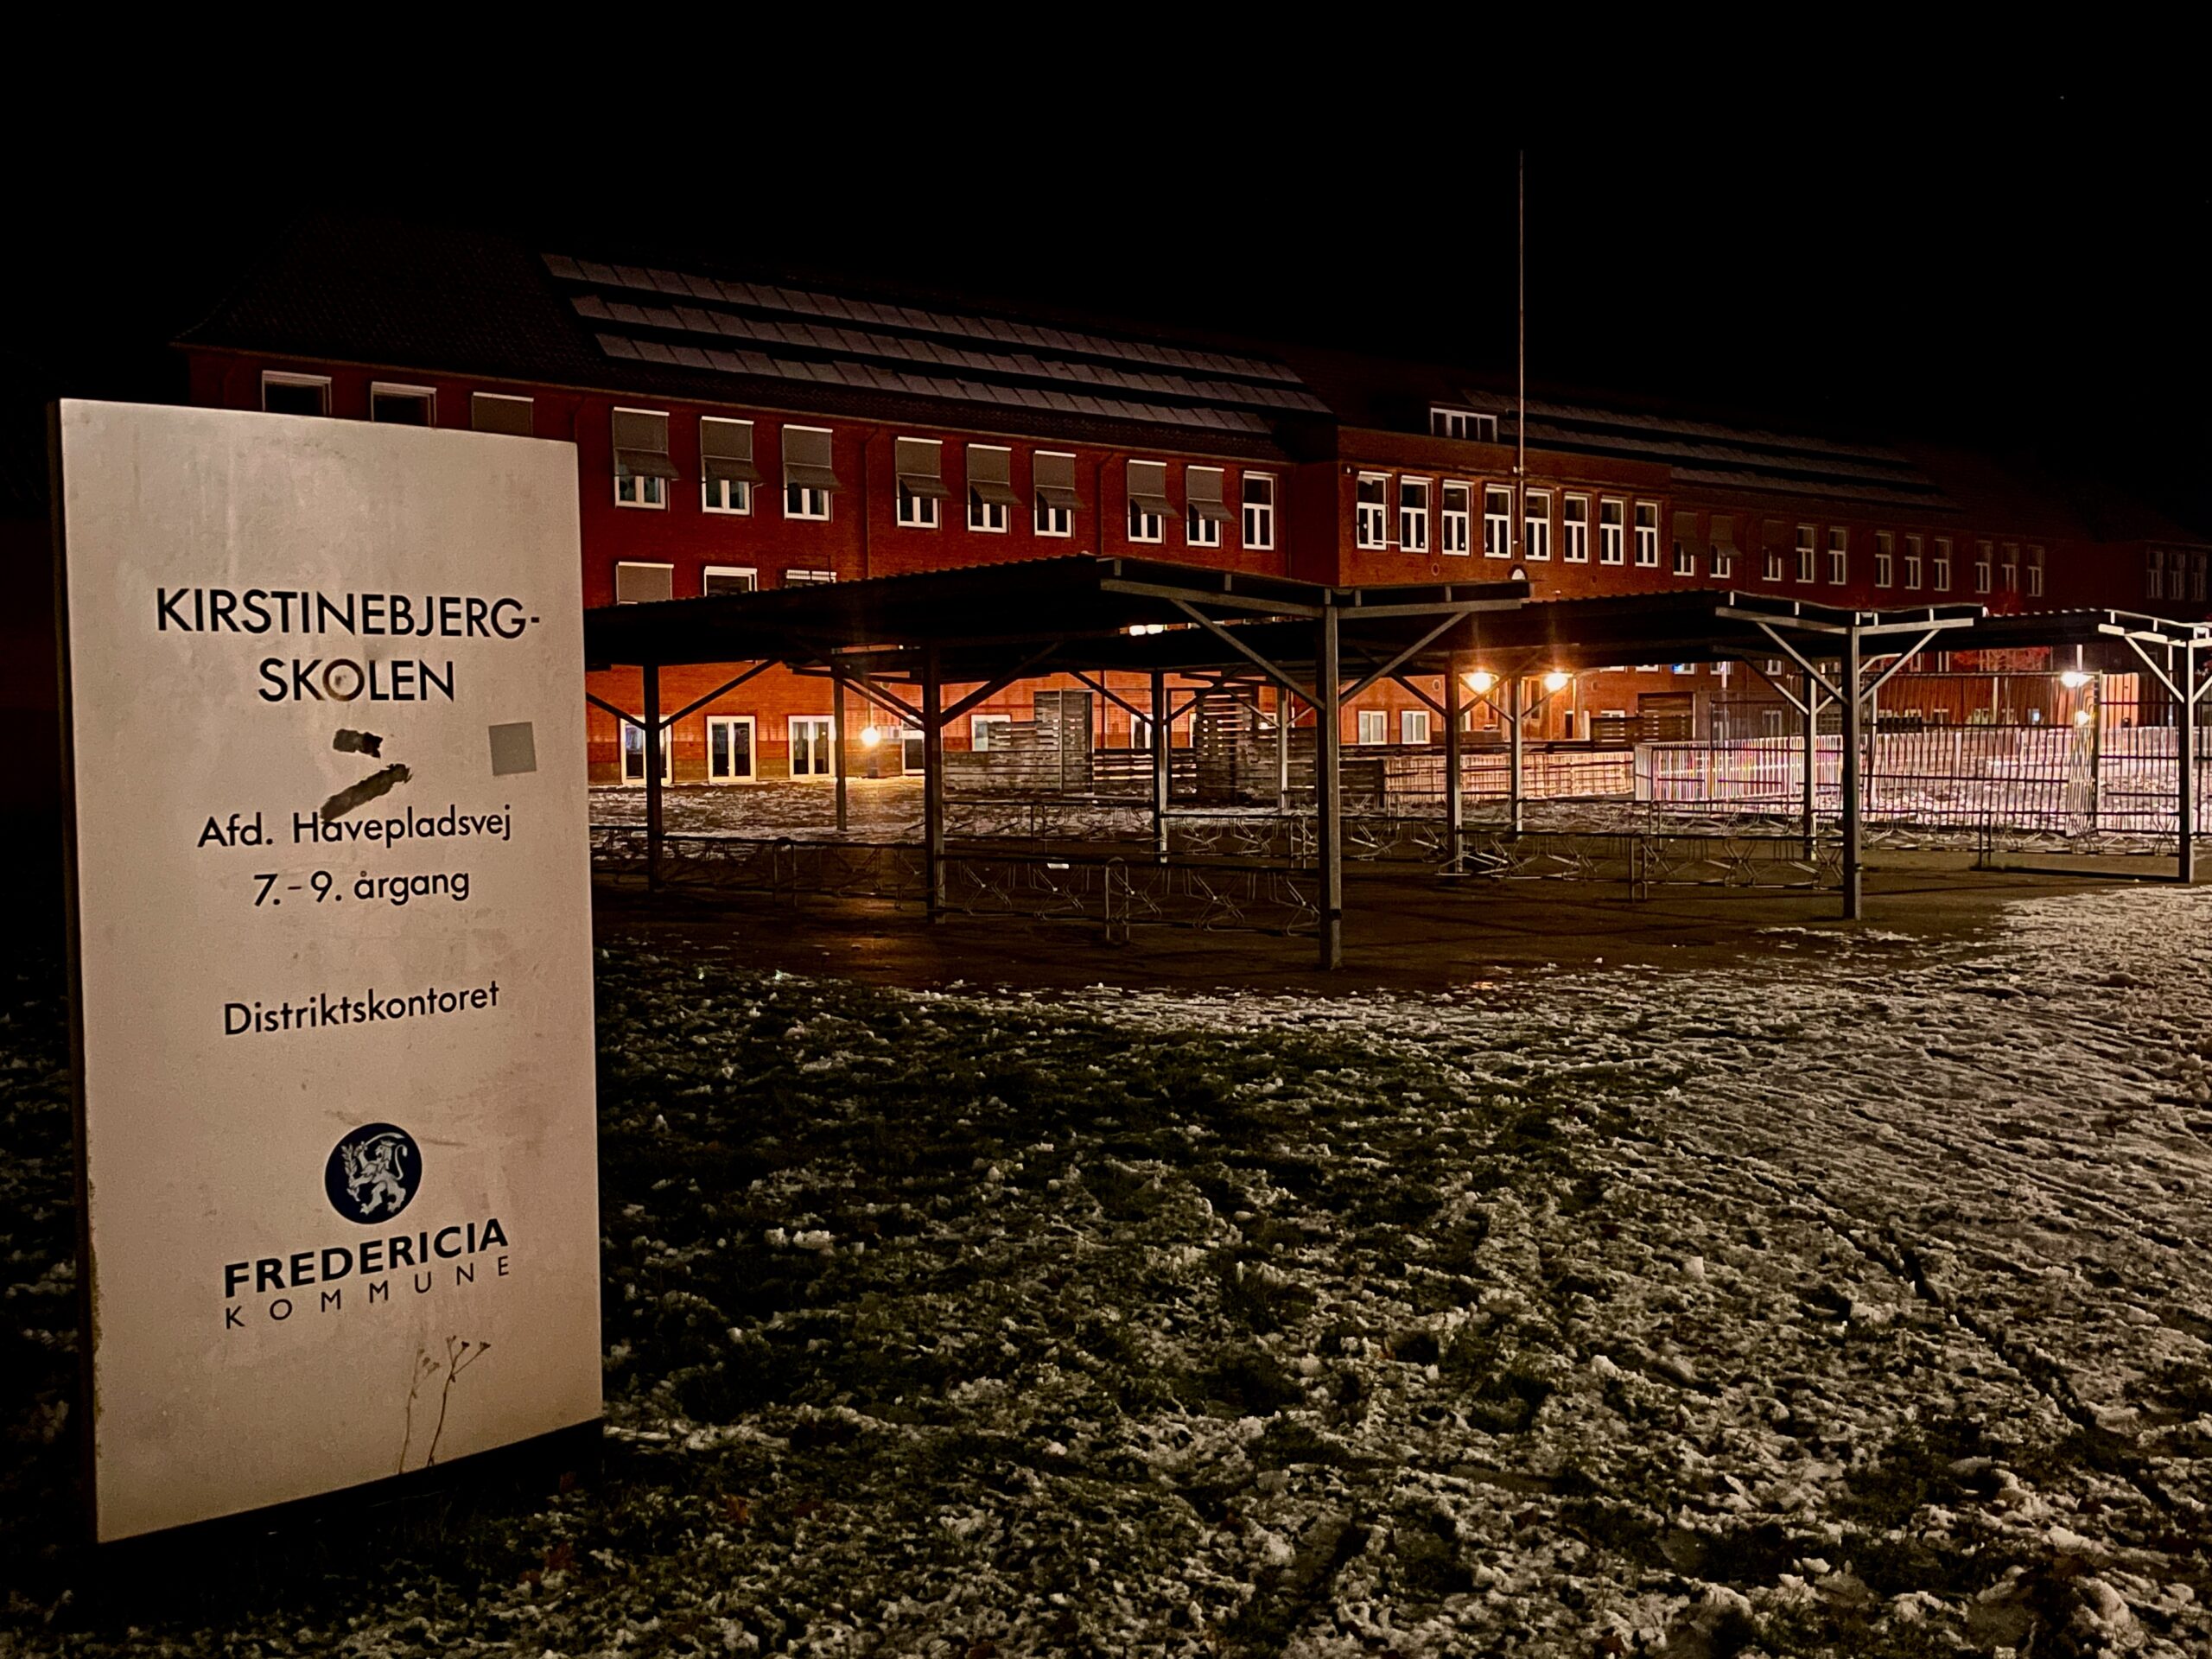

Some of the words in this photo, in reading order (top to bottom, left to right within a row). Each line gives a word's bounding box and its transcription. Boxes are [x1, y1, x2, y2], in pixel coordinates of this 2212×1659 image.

[156, 588, 541, 639] KIRSTINEBJERG-
[257, 658, 455, 702] SKOLEN
[197, 811, 274, 848] Afd.
[293, 804, 512, 849] Havepladsvej
[353, 870, 470, 906] årgang
[224, 980, 500, 1036] Distriktskontoret
[225, 1217, 509, 1298] FREDERICIA
[225, 1255, 510, 1330] KOMMUNE
